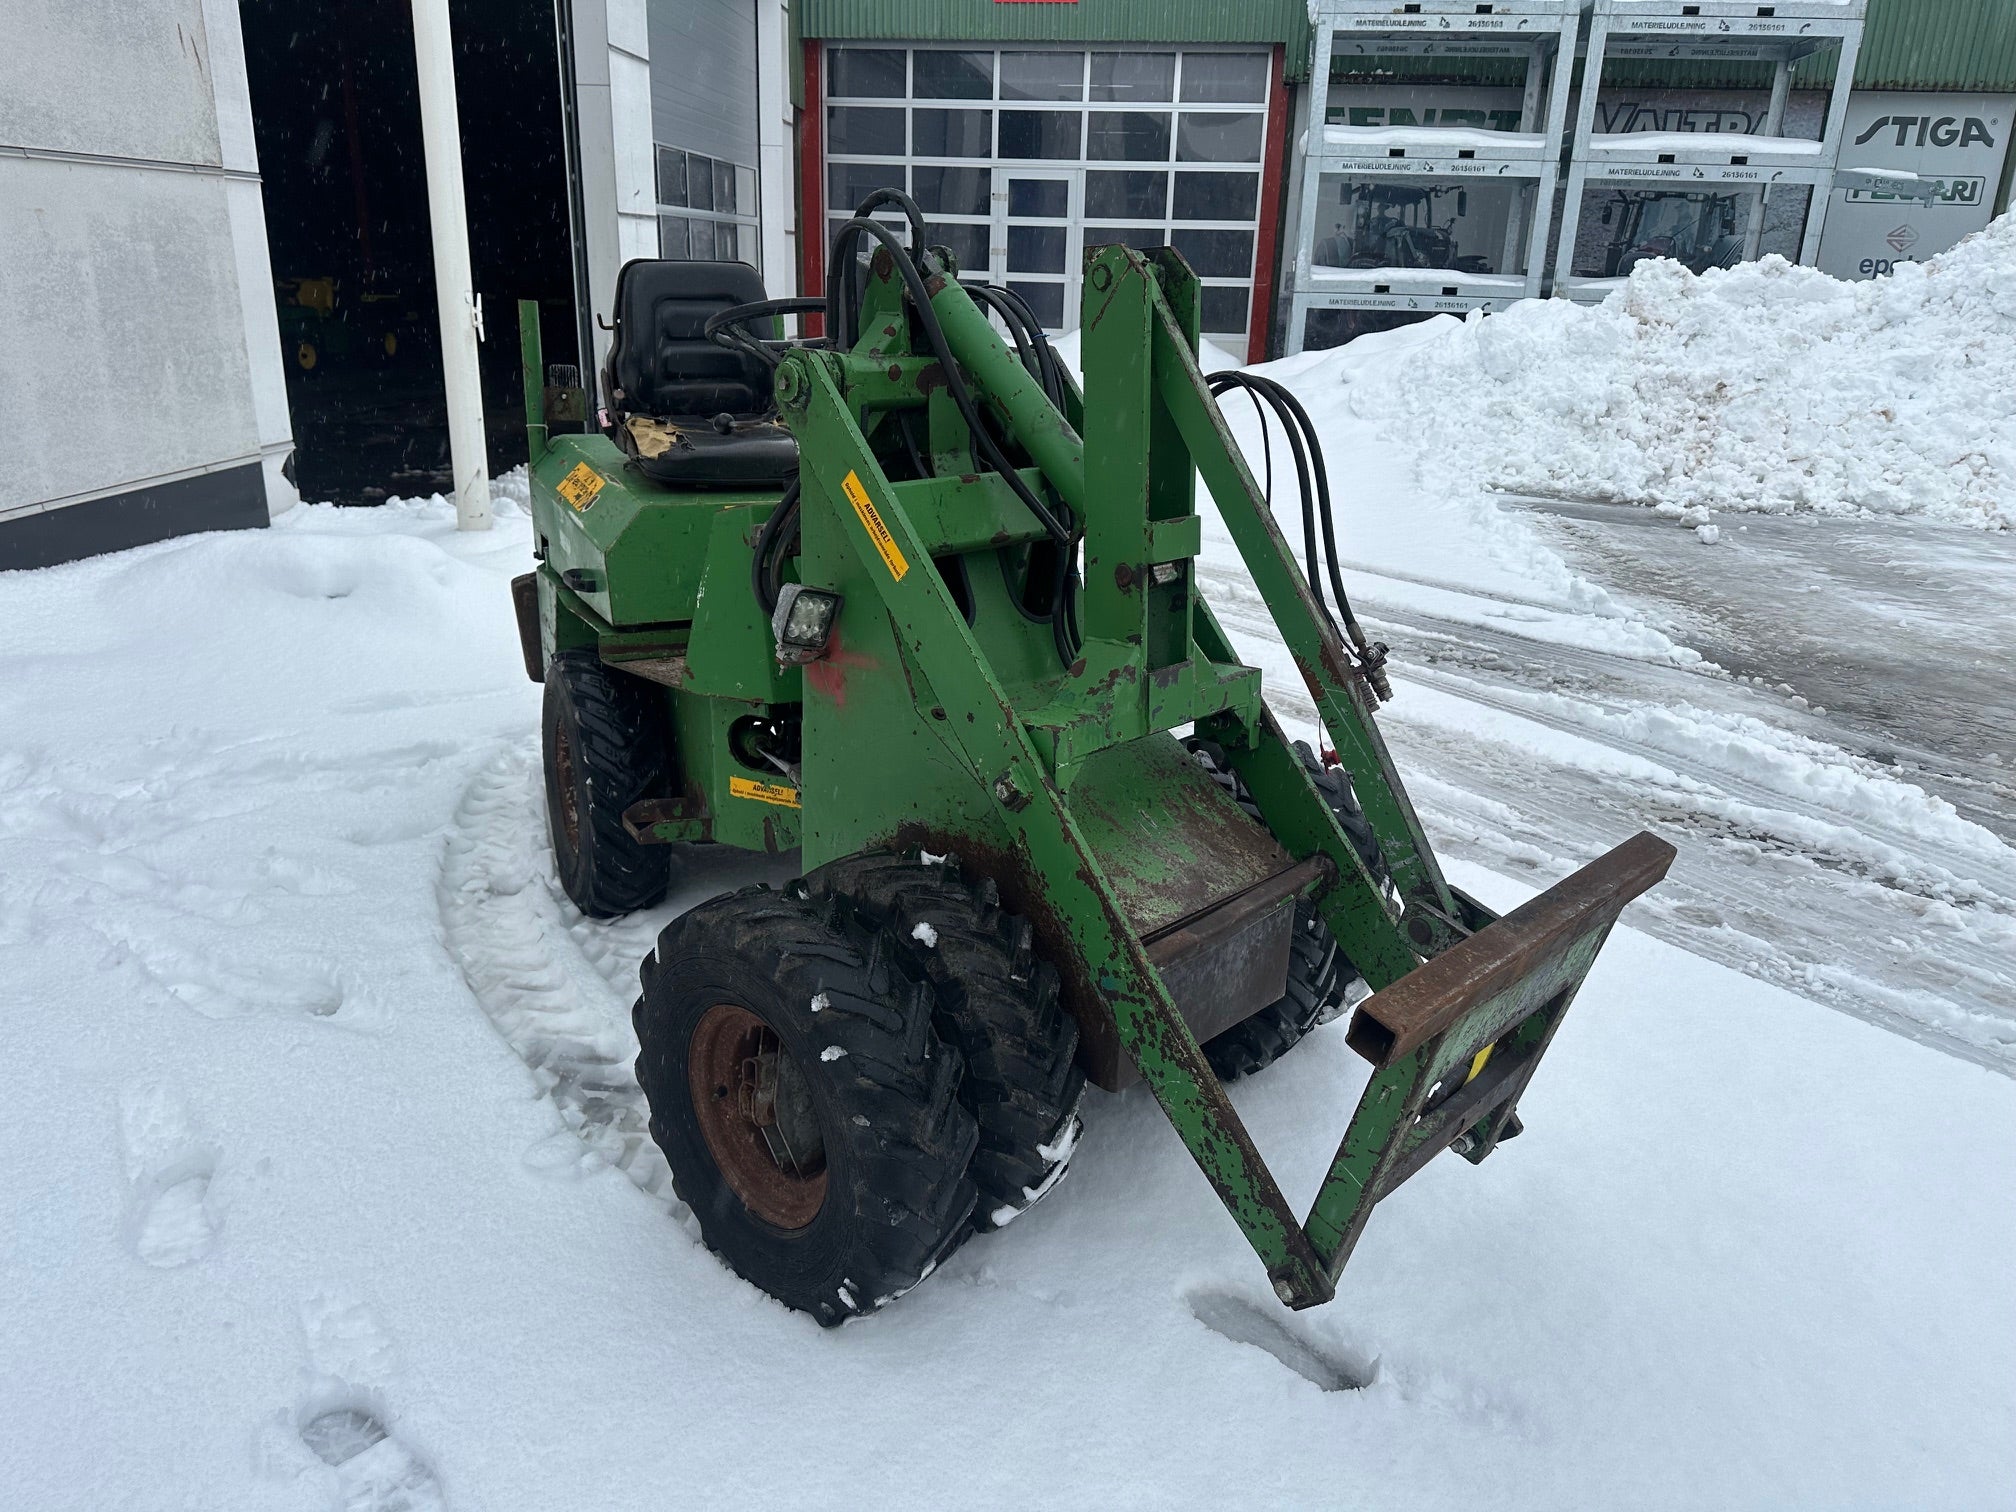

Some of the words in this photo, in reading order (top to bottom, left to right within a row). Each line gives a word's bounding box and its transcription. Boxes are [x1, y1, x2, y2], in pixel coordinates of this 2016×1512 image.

[1355, 19, 1427, 27] MATERIELUDLEJNING
[1631, 21, 1706, 30] MATERIELUDLEJNING
[1855, 116, 1994, 147] STIGA
[1342, 162, 1411, 171] MATERIELUDLEJNING
[1608, 168, 1681, 177] MATERIELUDLEJNING
[1328, 298, 1396, 307] MATERIELUDLEJNING
[864, 503, 891, 543] ADVARSEL!
